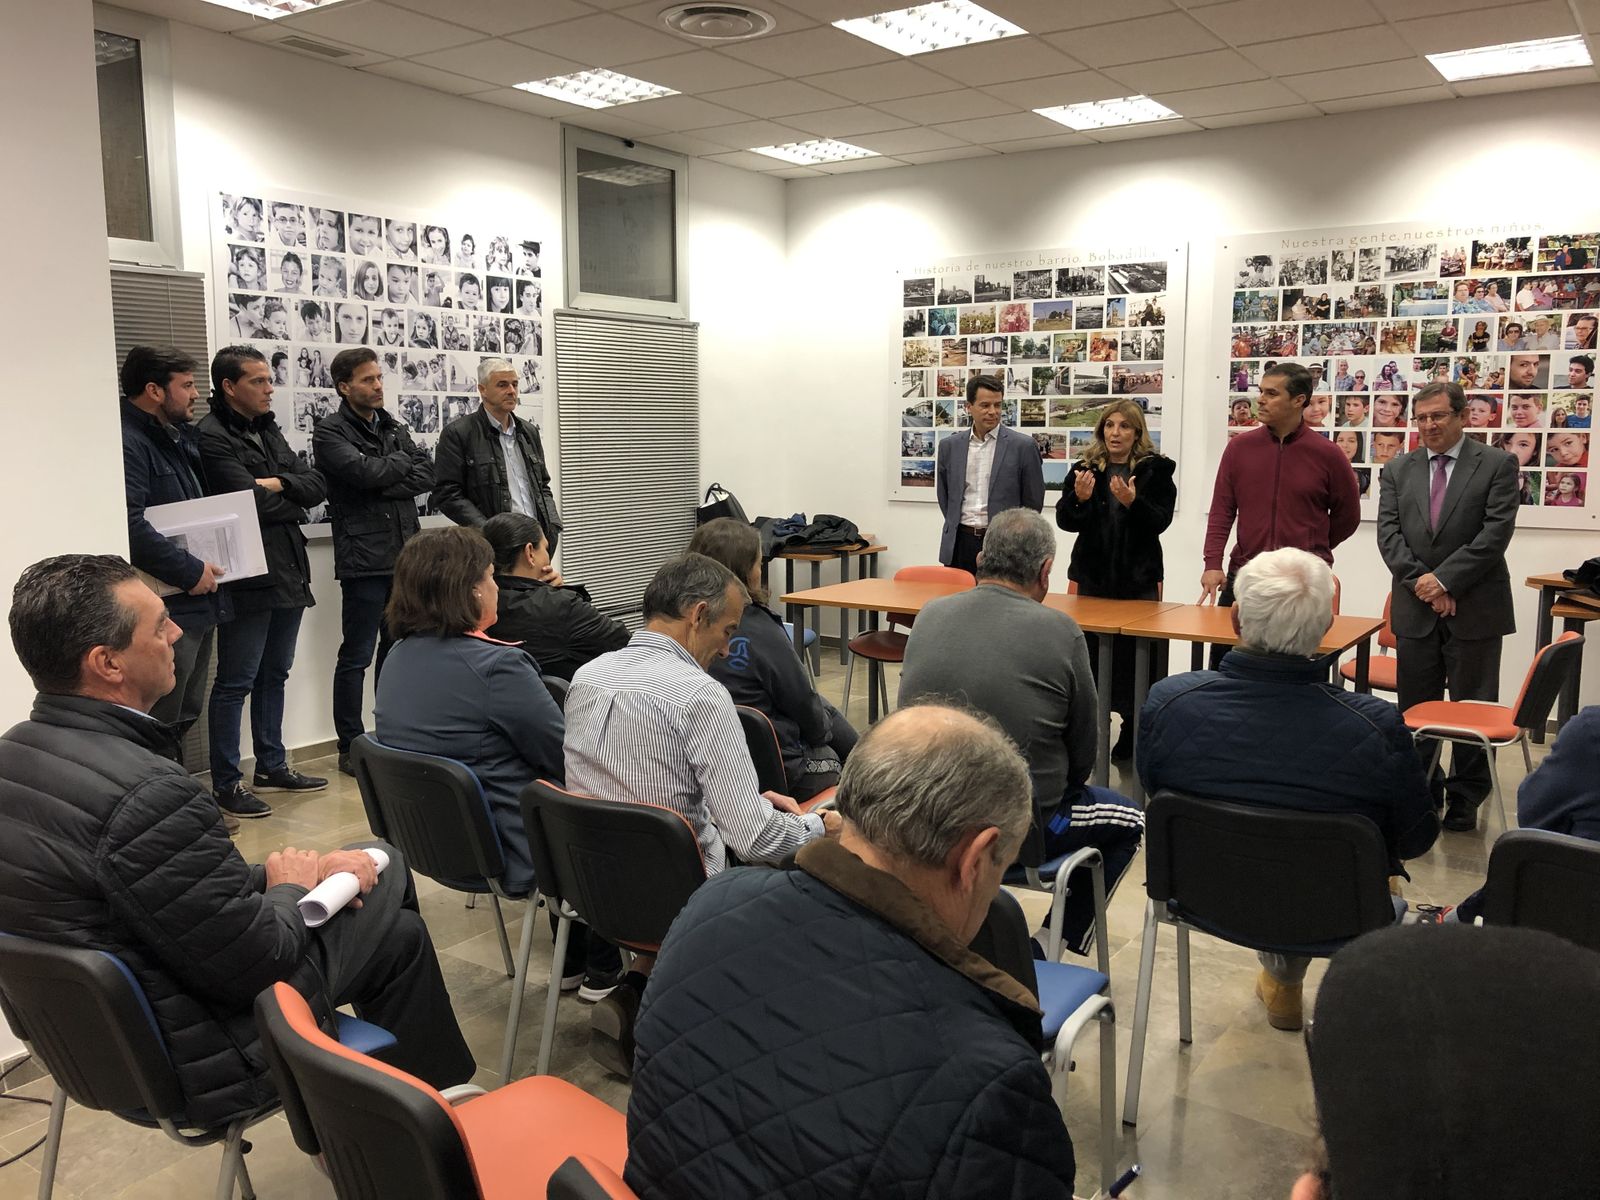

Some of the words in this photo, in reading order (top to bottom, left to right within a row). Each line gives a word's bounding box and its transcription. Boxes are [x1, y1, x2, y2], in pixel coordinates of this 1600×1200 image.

[1281, 235, 1344, 249] Nuestra
[966, 259, 980, 272] de
[985, 258, 1033, 270] nuestro
